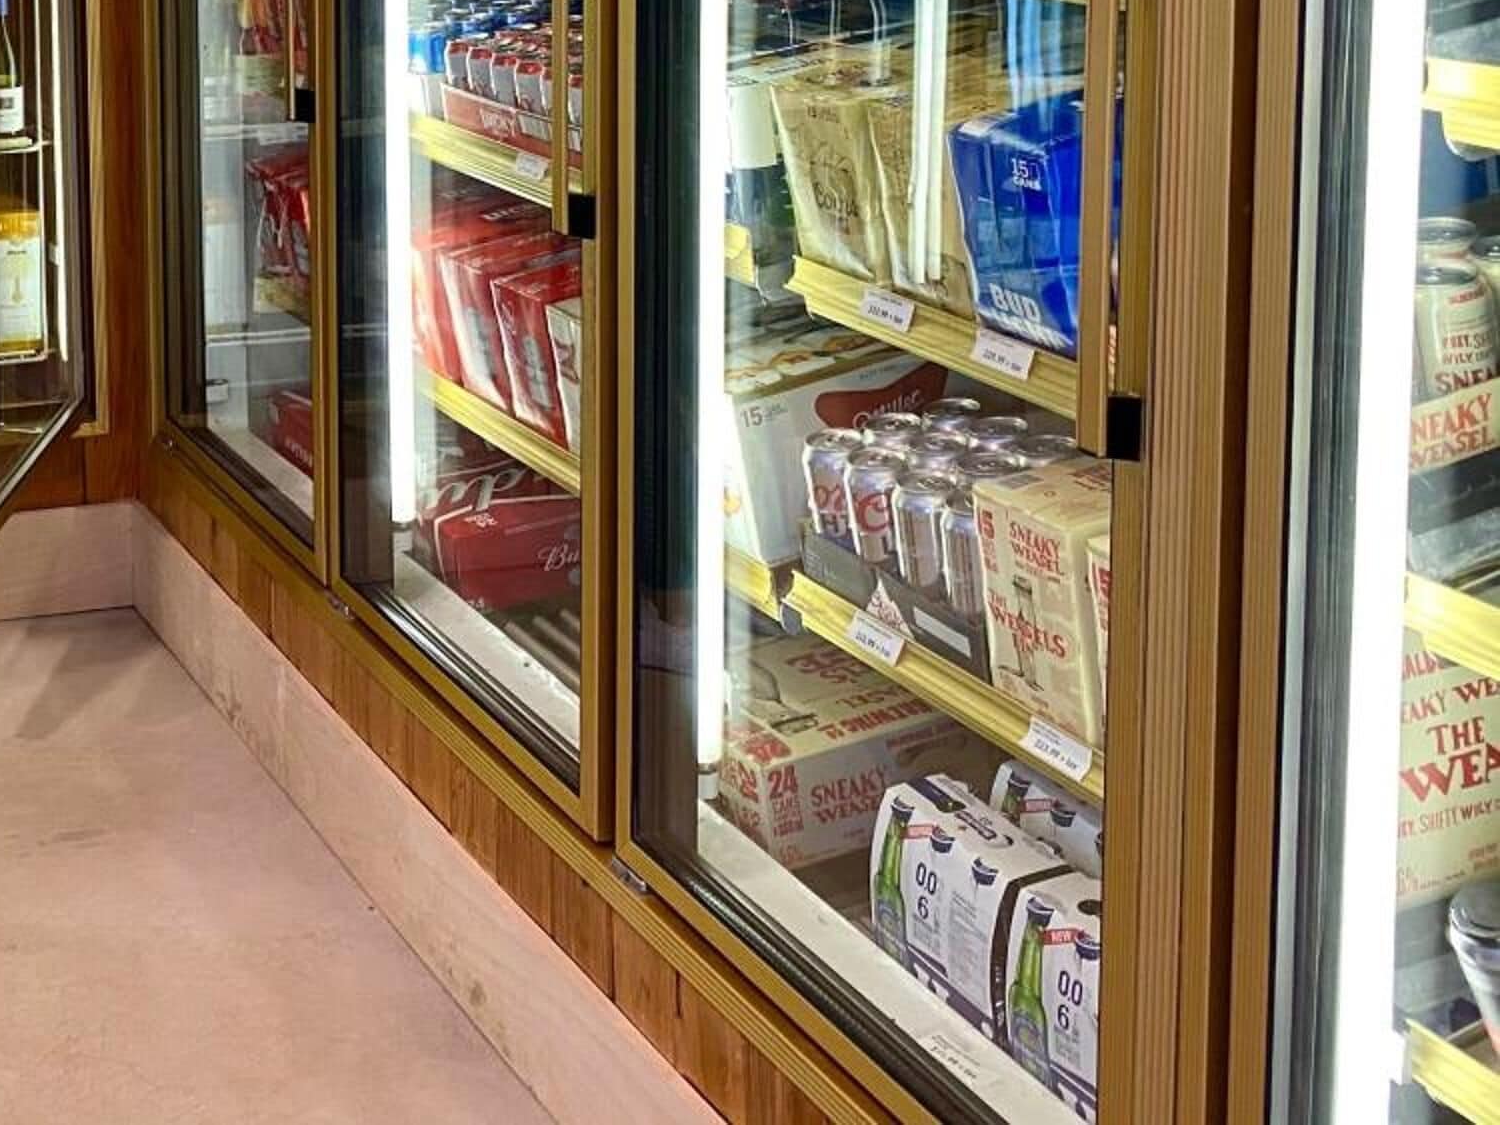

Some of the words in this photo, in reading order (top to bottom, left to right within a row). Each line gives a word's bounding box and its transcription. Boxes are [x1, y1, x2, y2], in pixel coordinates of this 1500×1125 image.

[1011, 158, 1029, 178] 15
[989, 282, 1040, 322] BUD
[1411, 394, 1492, 442] NEAKY
[1009, 522, 1061, 558] SNEAKY
[1426, 716, 1484, 756] THE
[768, 764, 799, 801] 24
[811, 764, 886, 807] SNEAKY
[917, 896, 929, 920] 6
[1058, 1004, 1070, 1030] 6
